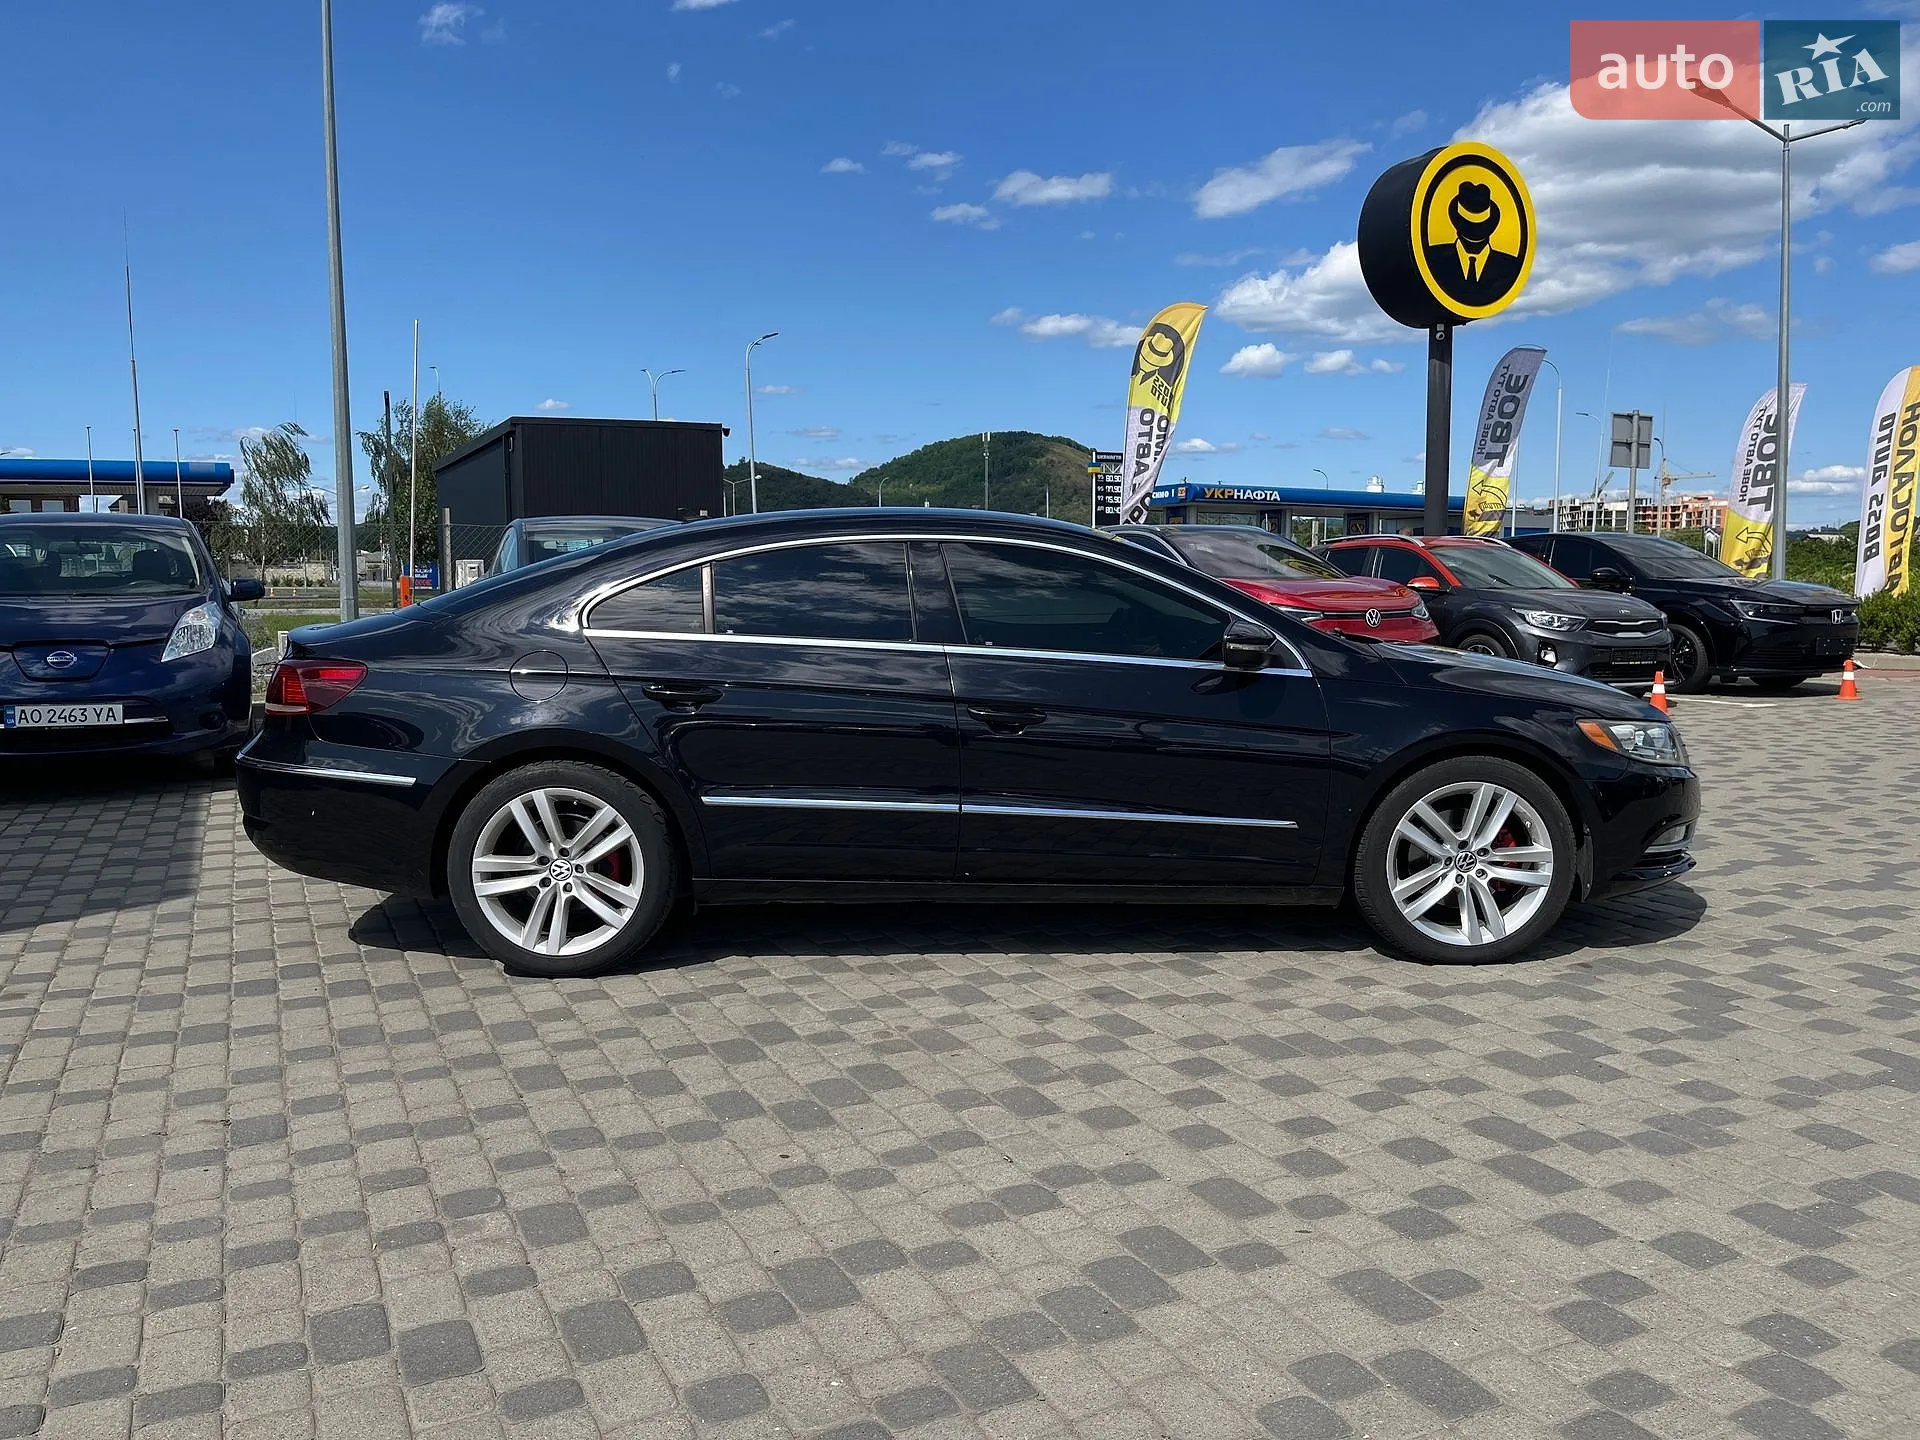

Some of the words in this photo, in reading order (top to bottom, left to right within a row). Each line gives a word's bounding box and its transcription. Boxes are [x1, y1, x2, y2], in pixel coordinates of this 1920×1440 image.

[1204, 488, 1280, 501] УКРНАФТА
[18, 708, 42, 724] AO
[47, 707, 88, 723] 2463
[93, 706, 117, 722] YA
